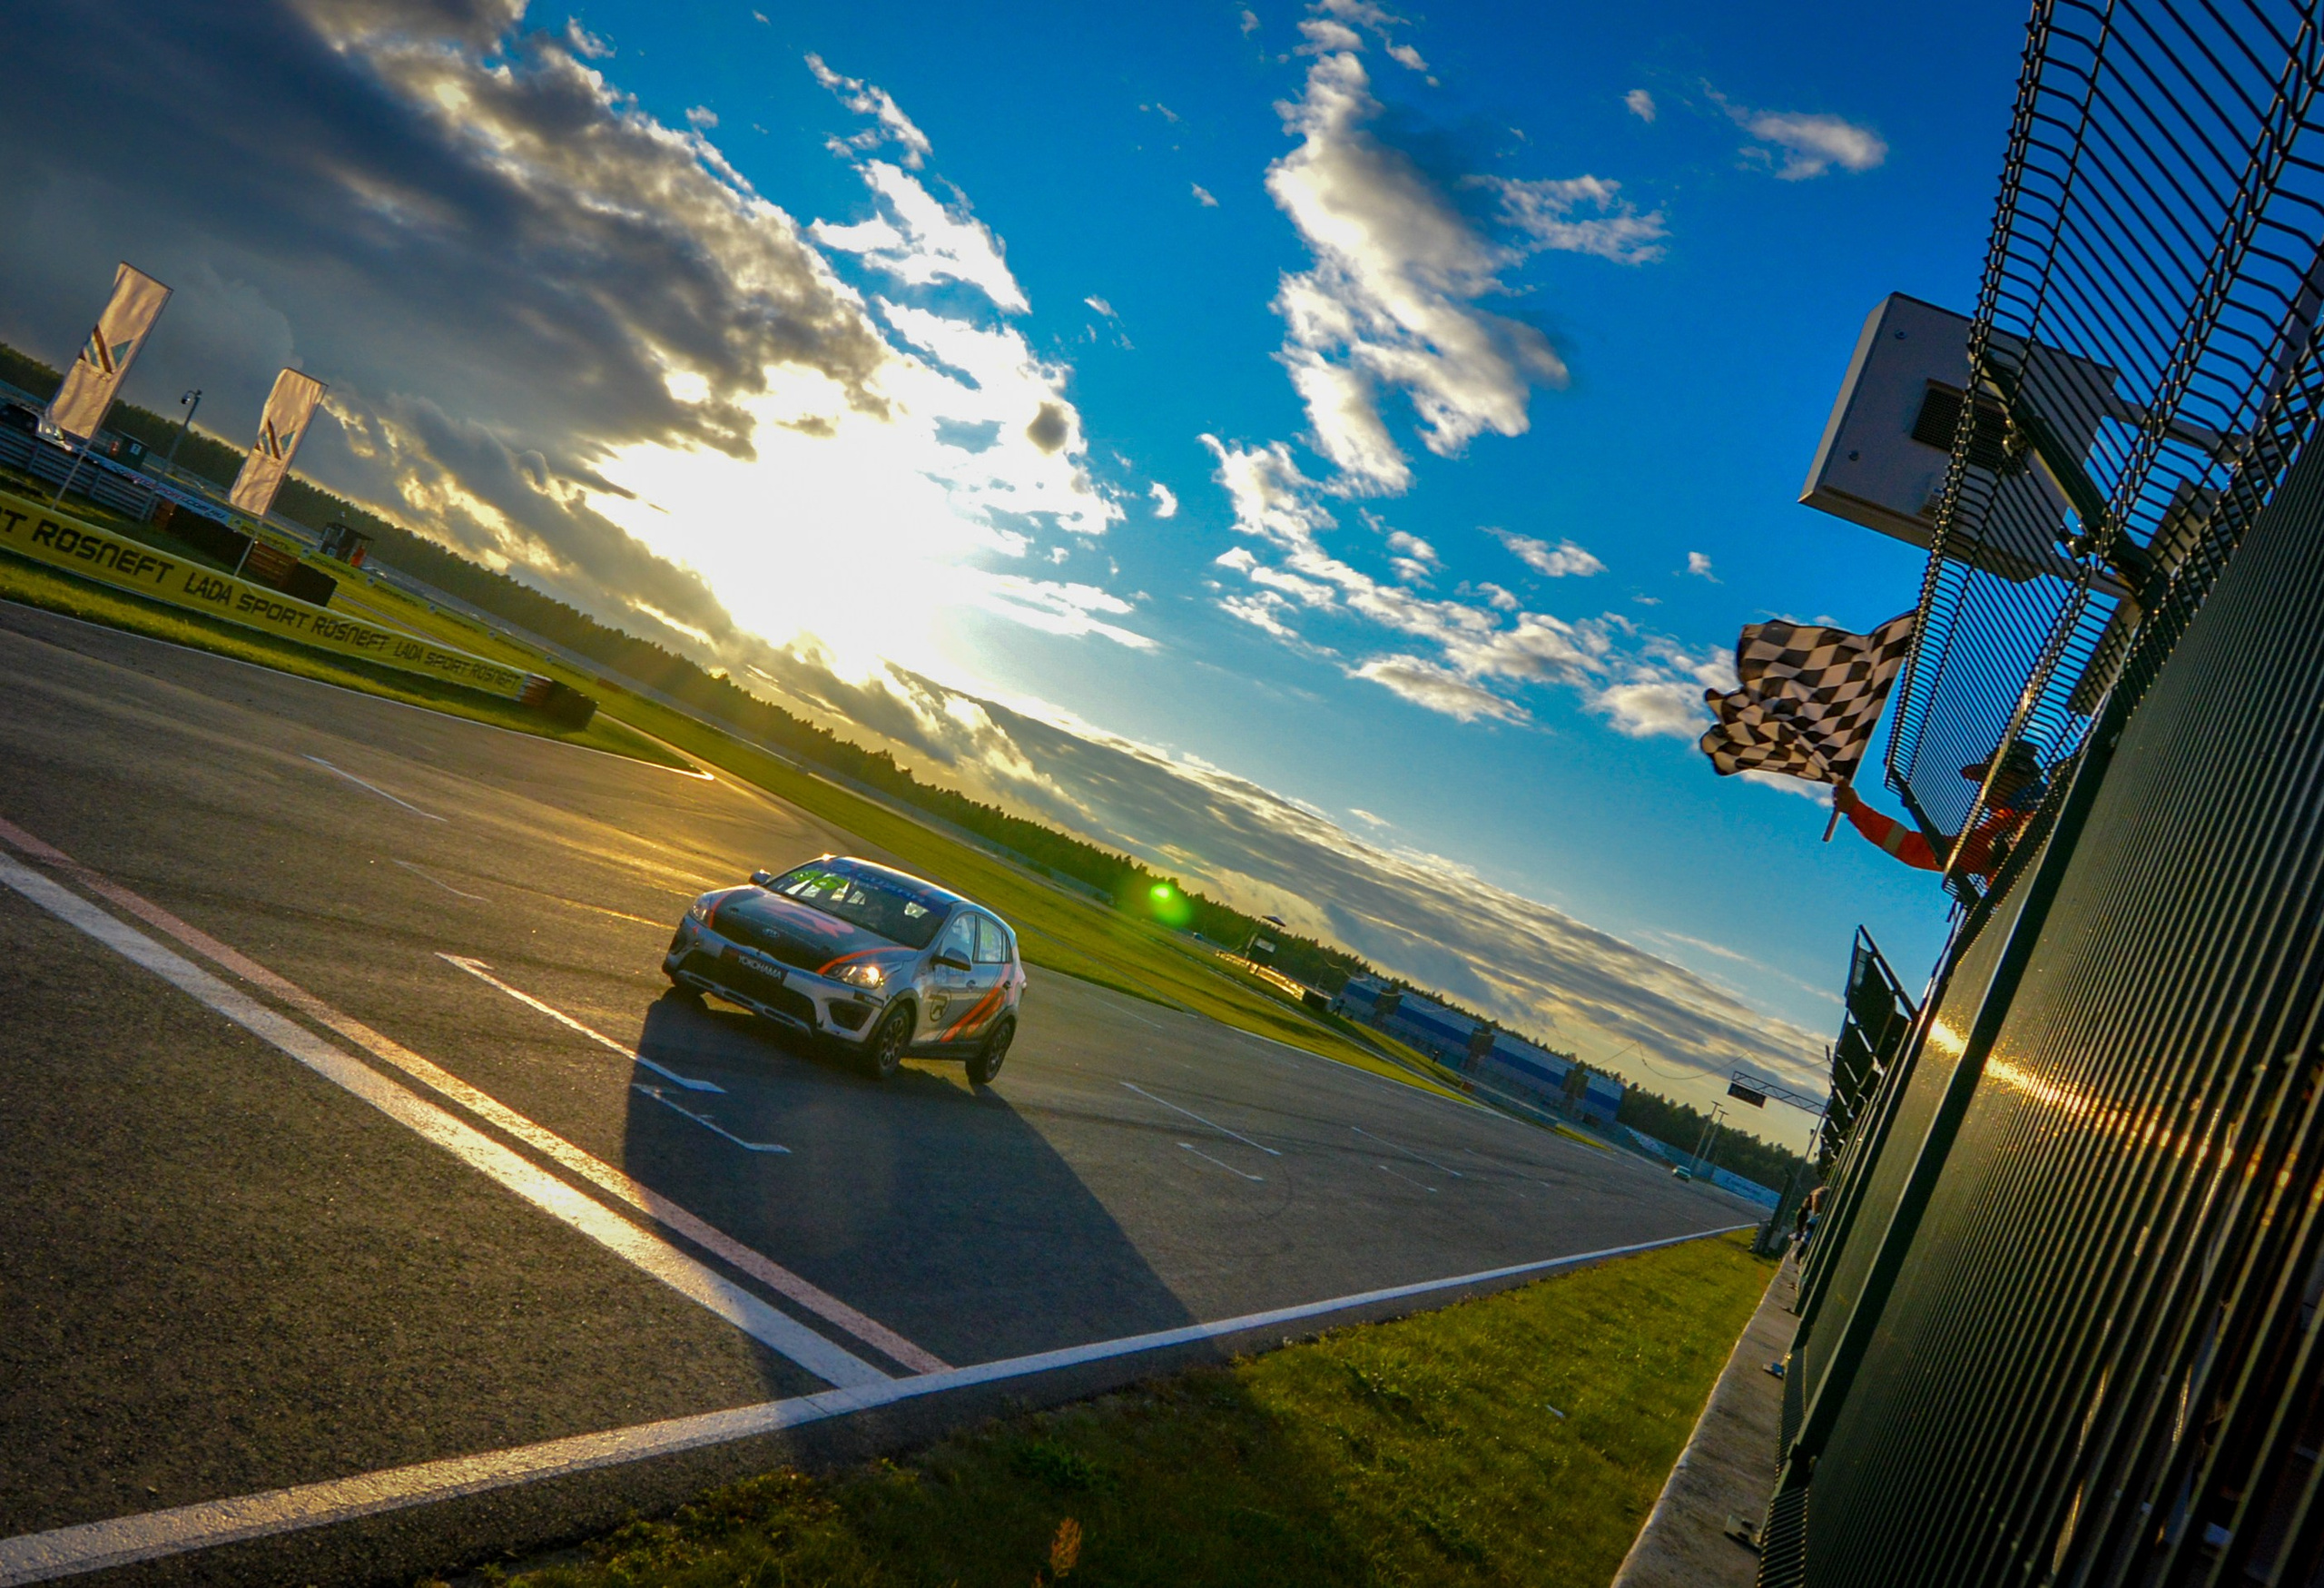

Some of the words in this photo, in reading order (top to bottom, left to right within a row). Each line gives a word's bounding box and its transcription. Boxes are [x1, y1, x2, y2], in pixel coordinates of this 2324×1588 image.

[0, 506, 28, 533] T
[32, 518, 174, 584] ROSNEFT
[183, 572, 232, 607] LADA
[236, 593, 310, 628] SPORT
[310, 615, 390, 652] ROSNEFT
[393, 640, 424, 663] LADA
[424, 652, 471, 674] SPORT
[469, 662, 521, 690] ROSNEFT
[738, 954, 781, 980] YOKOHAMA
